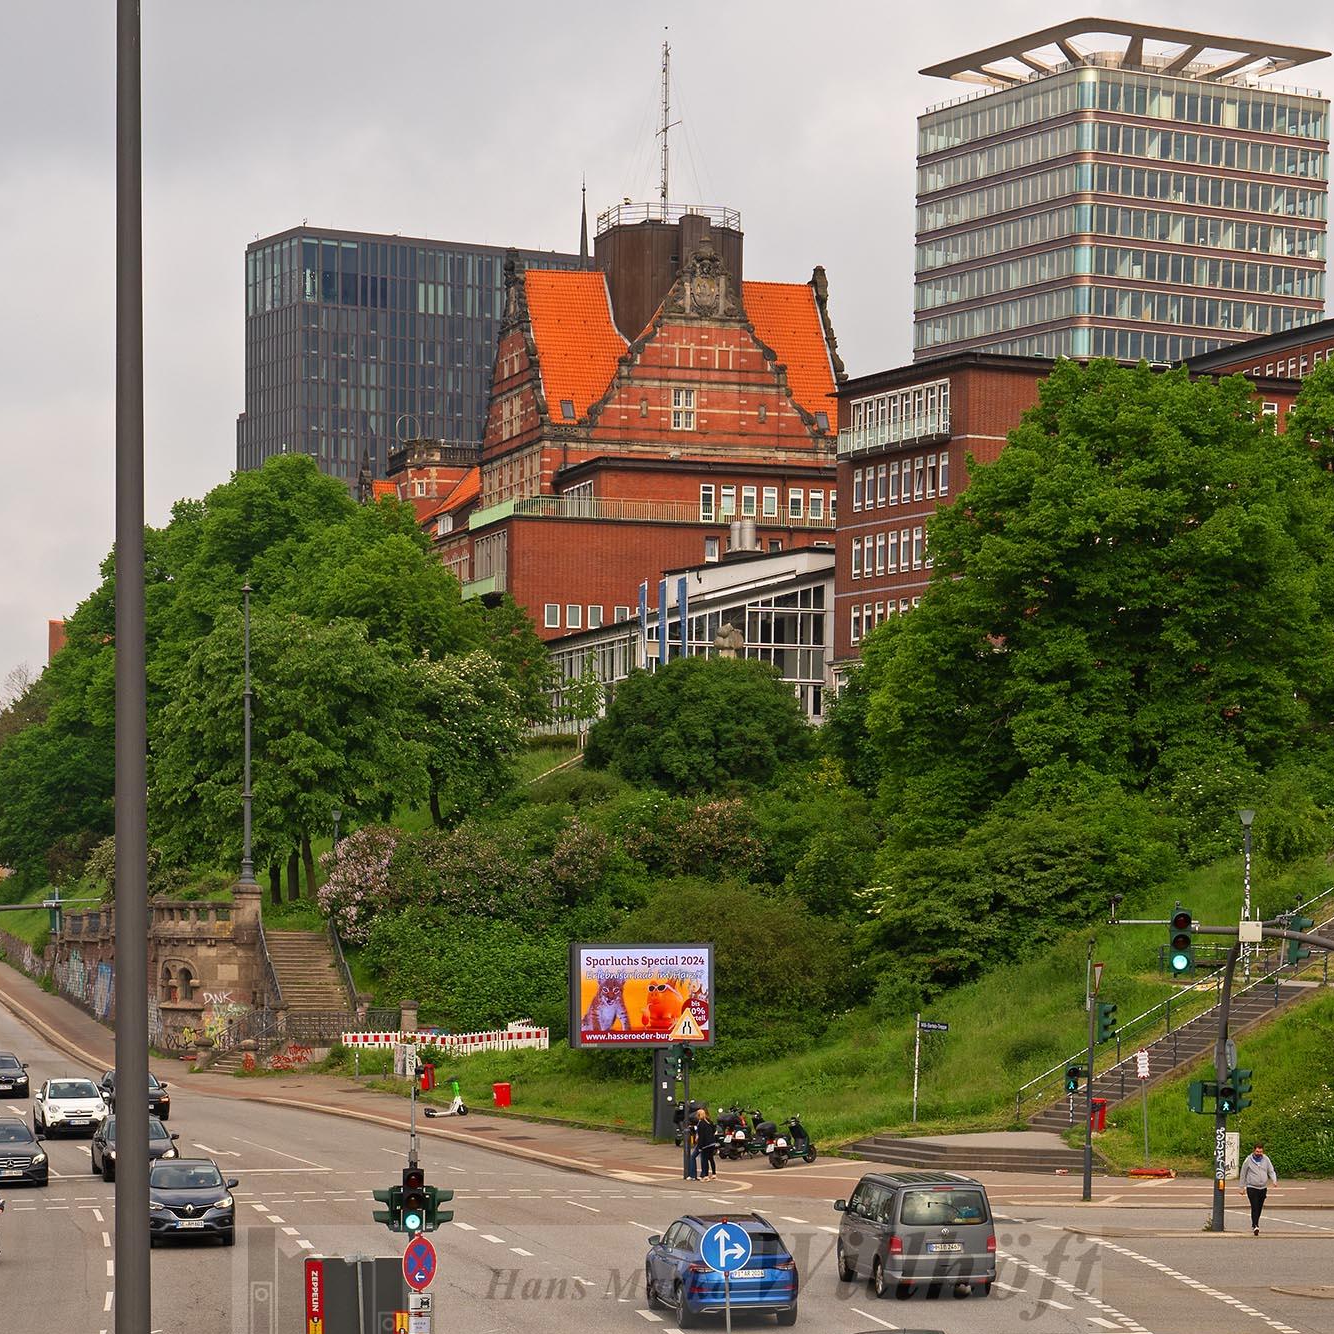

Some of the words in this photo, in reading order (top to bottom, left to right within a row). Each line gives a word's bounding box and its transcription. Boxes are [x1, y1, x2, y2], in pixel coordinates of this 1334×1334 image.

[585, 955, 640, 968] Sparluchs
[641, 955, 679, 968] Special
[680, 957, 705, 966] 2024
[688, 1006, 706, 1015] 0%
[311, 1270, 320, 1313] ZEPPELIN
